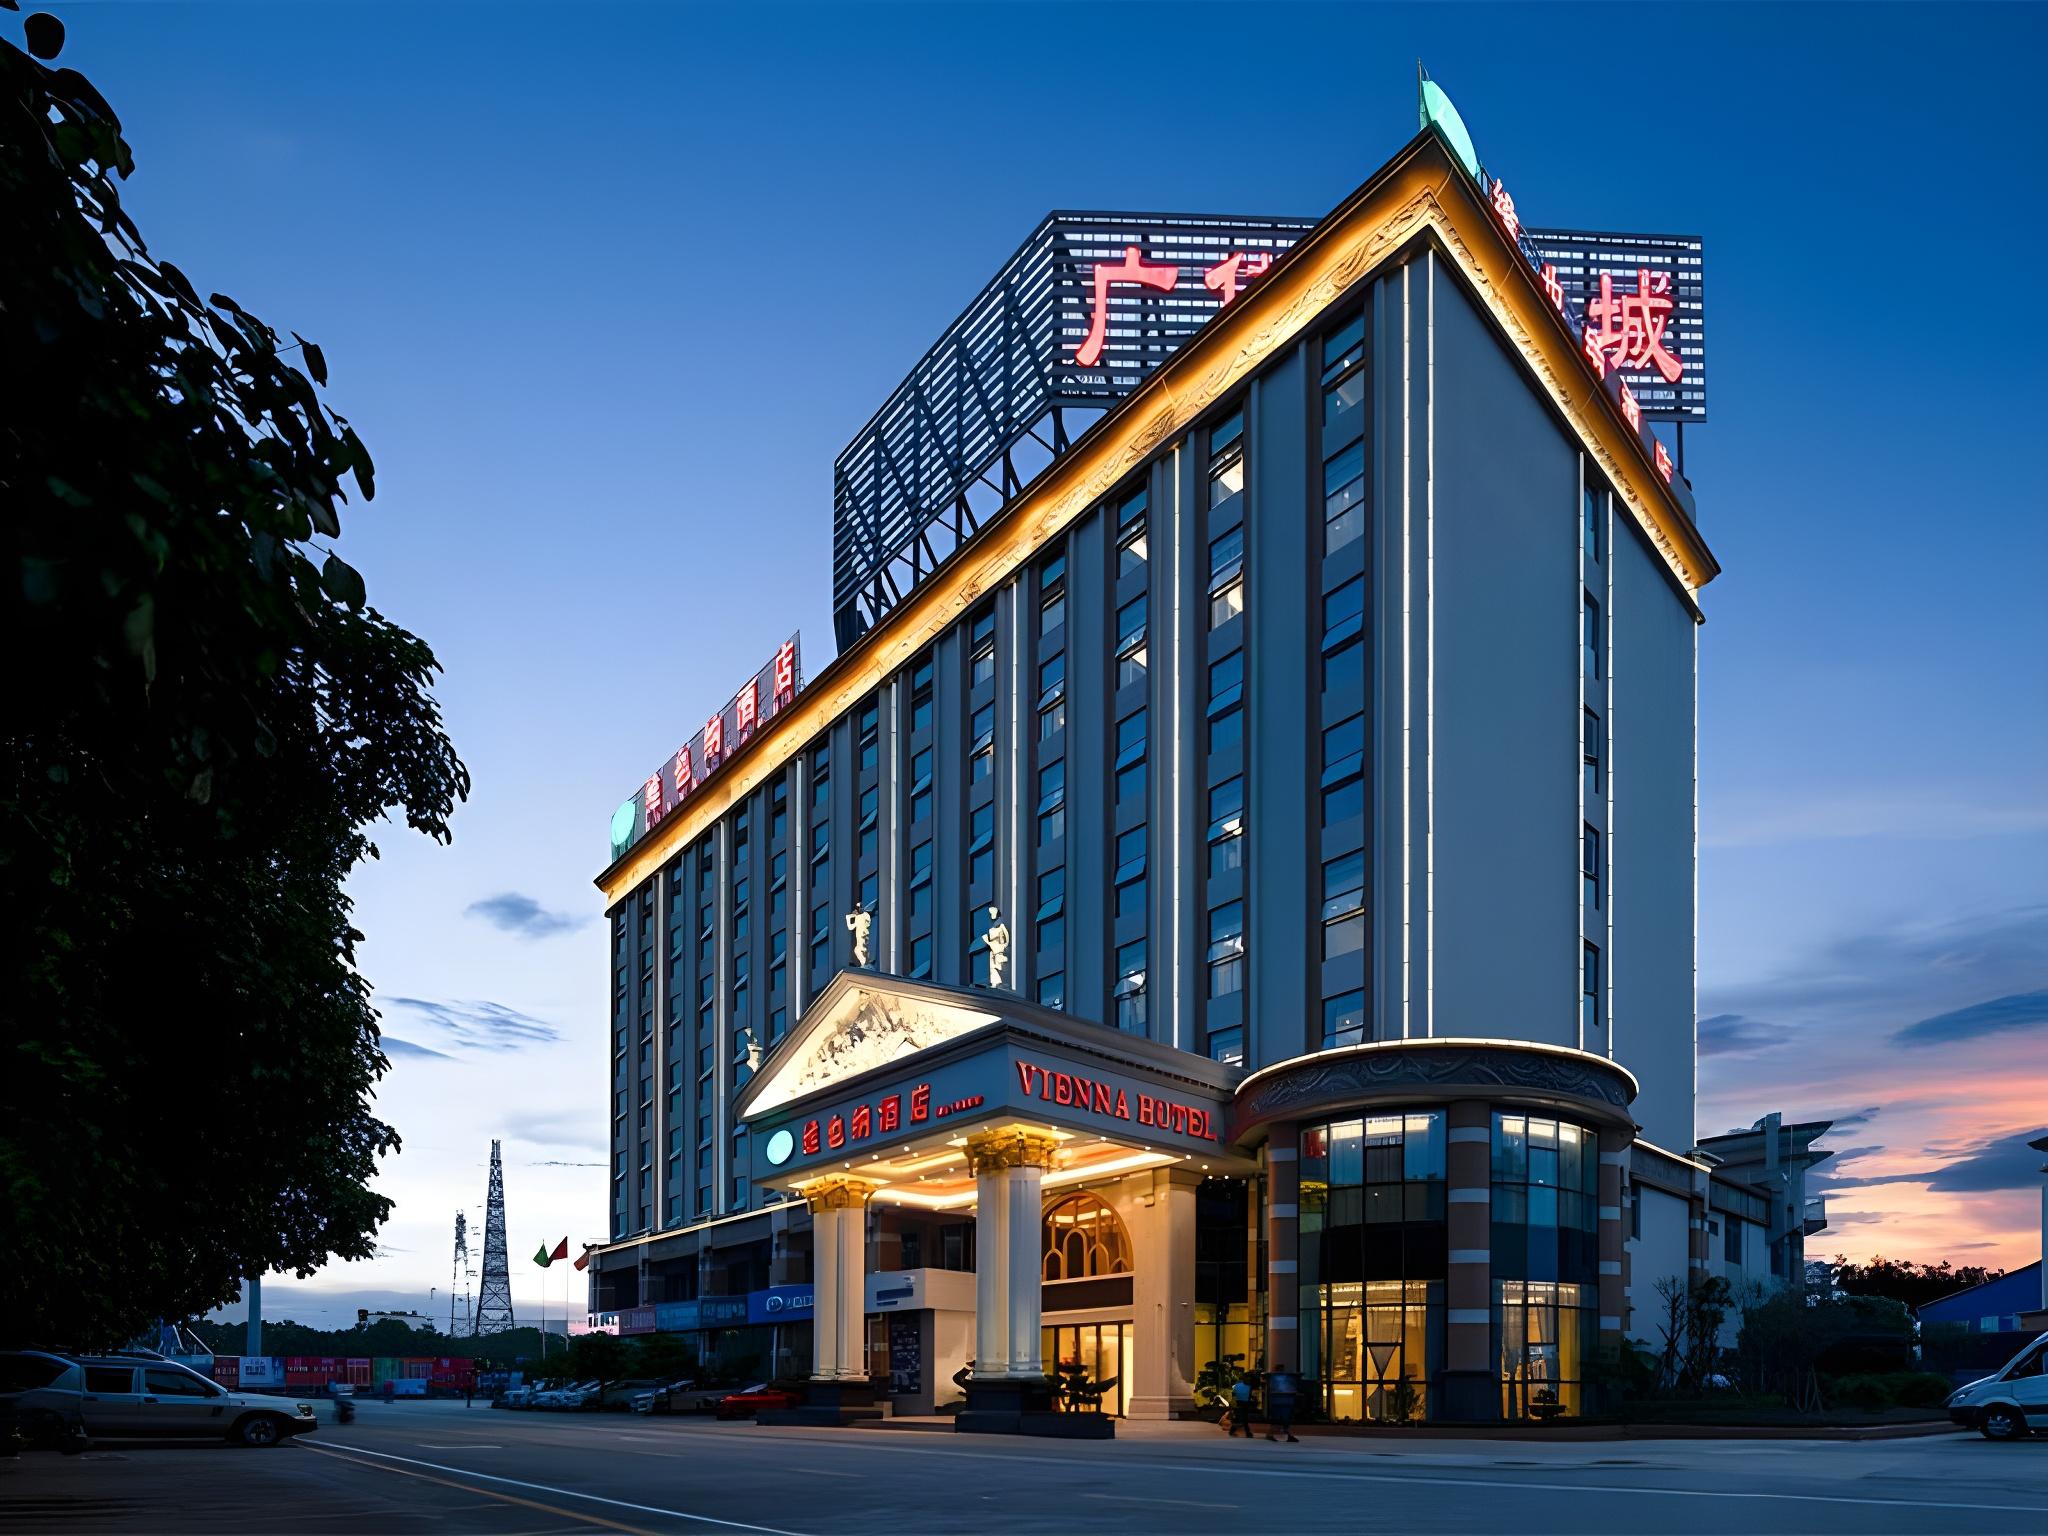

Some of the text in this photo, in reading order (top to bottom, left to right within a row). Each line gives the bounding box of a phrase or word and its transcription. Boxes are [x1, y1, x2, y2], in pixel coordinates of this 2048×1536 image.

[1588, 268, 1684, 384] 城
[1016, 1060, 1130, 1121] VIENNA
[1137, 1093, 1217, 1141] HOTEL
